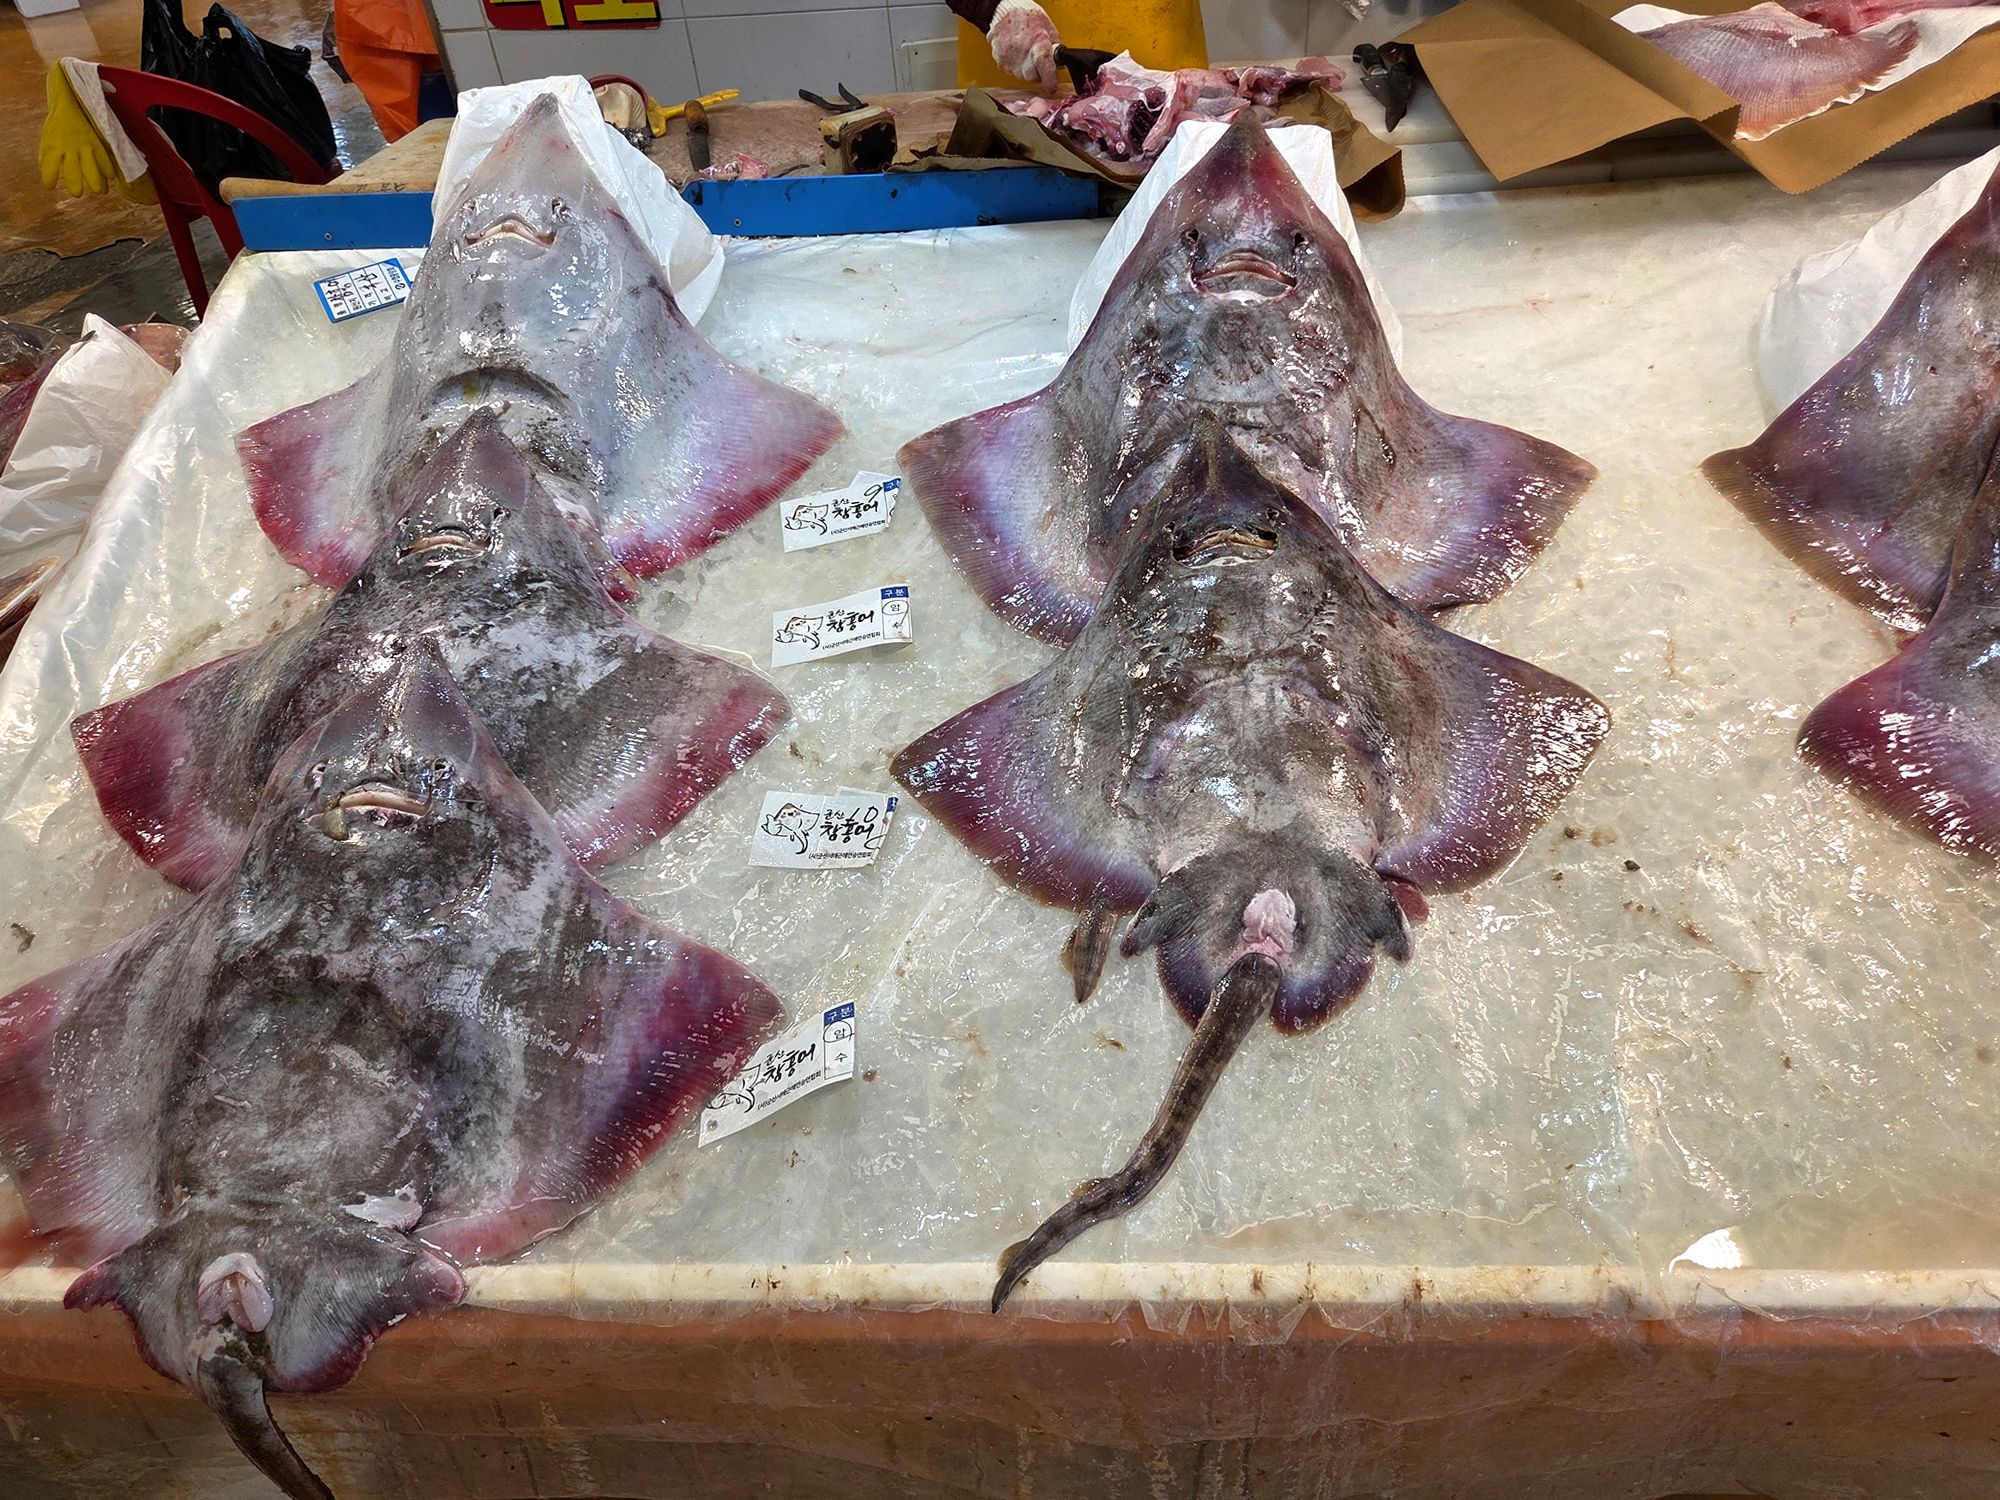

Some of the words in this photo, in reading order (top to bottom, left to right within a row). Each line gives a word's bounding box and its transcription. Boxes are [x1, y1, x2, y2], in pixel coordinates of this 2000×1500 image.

[864, 484, 883, 503] 9
[883, 588, 905, 598] 구분
[826, 608, 845, 619] 군산
[890, 603, 900, 612] 암
[823, 808, 846, 821] 군산
[828, 1006, 853, 1021] 구분
[833, 1027, 846, 1040] 암
[764, 1049, 786, 1066] 군산
[834, 1051, 849, 1063] 수
